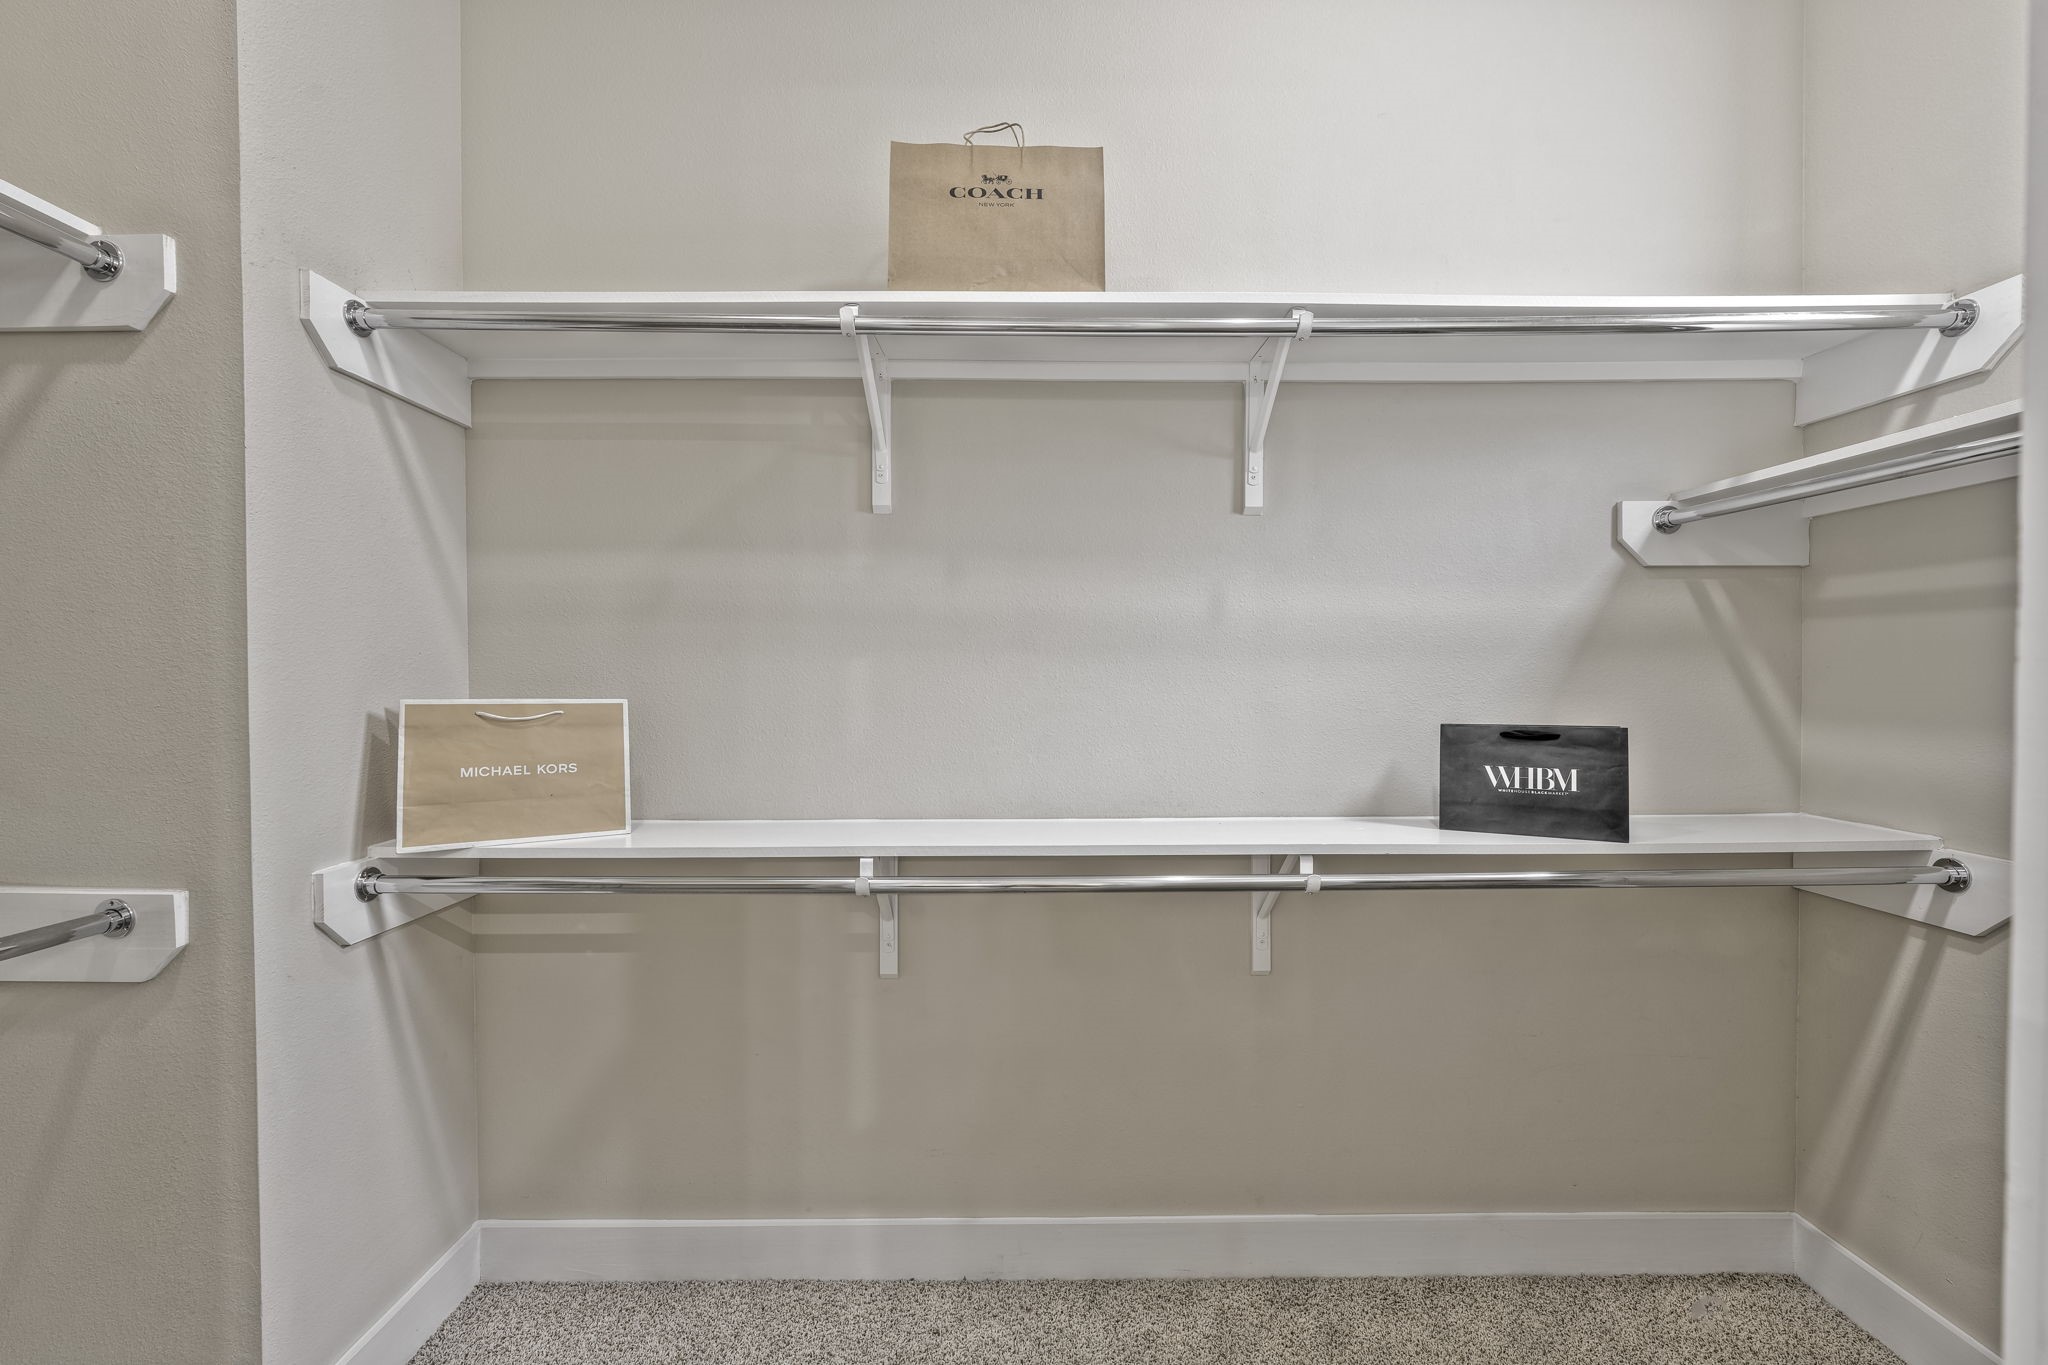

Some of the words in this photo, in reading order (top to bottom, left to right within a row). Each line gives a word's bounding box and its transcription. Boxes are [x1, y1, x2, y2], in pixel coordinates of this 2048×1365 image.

[949, 186, 1045, 200] COACH
[460, 765, 531, 778] MICHAEL
[537, 763, 578, 775] KORS
[1483, 765, 1581, 792] WHBM
